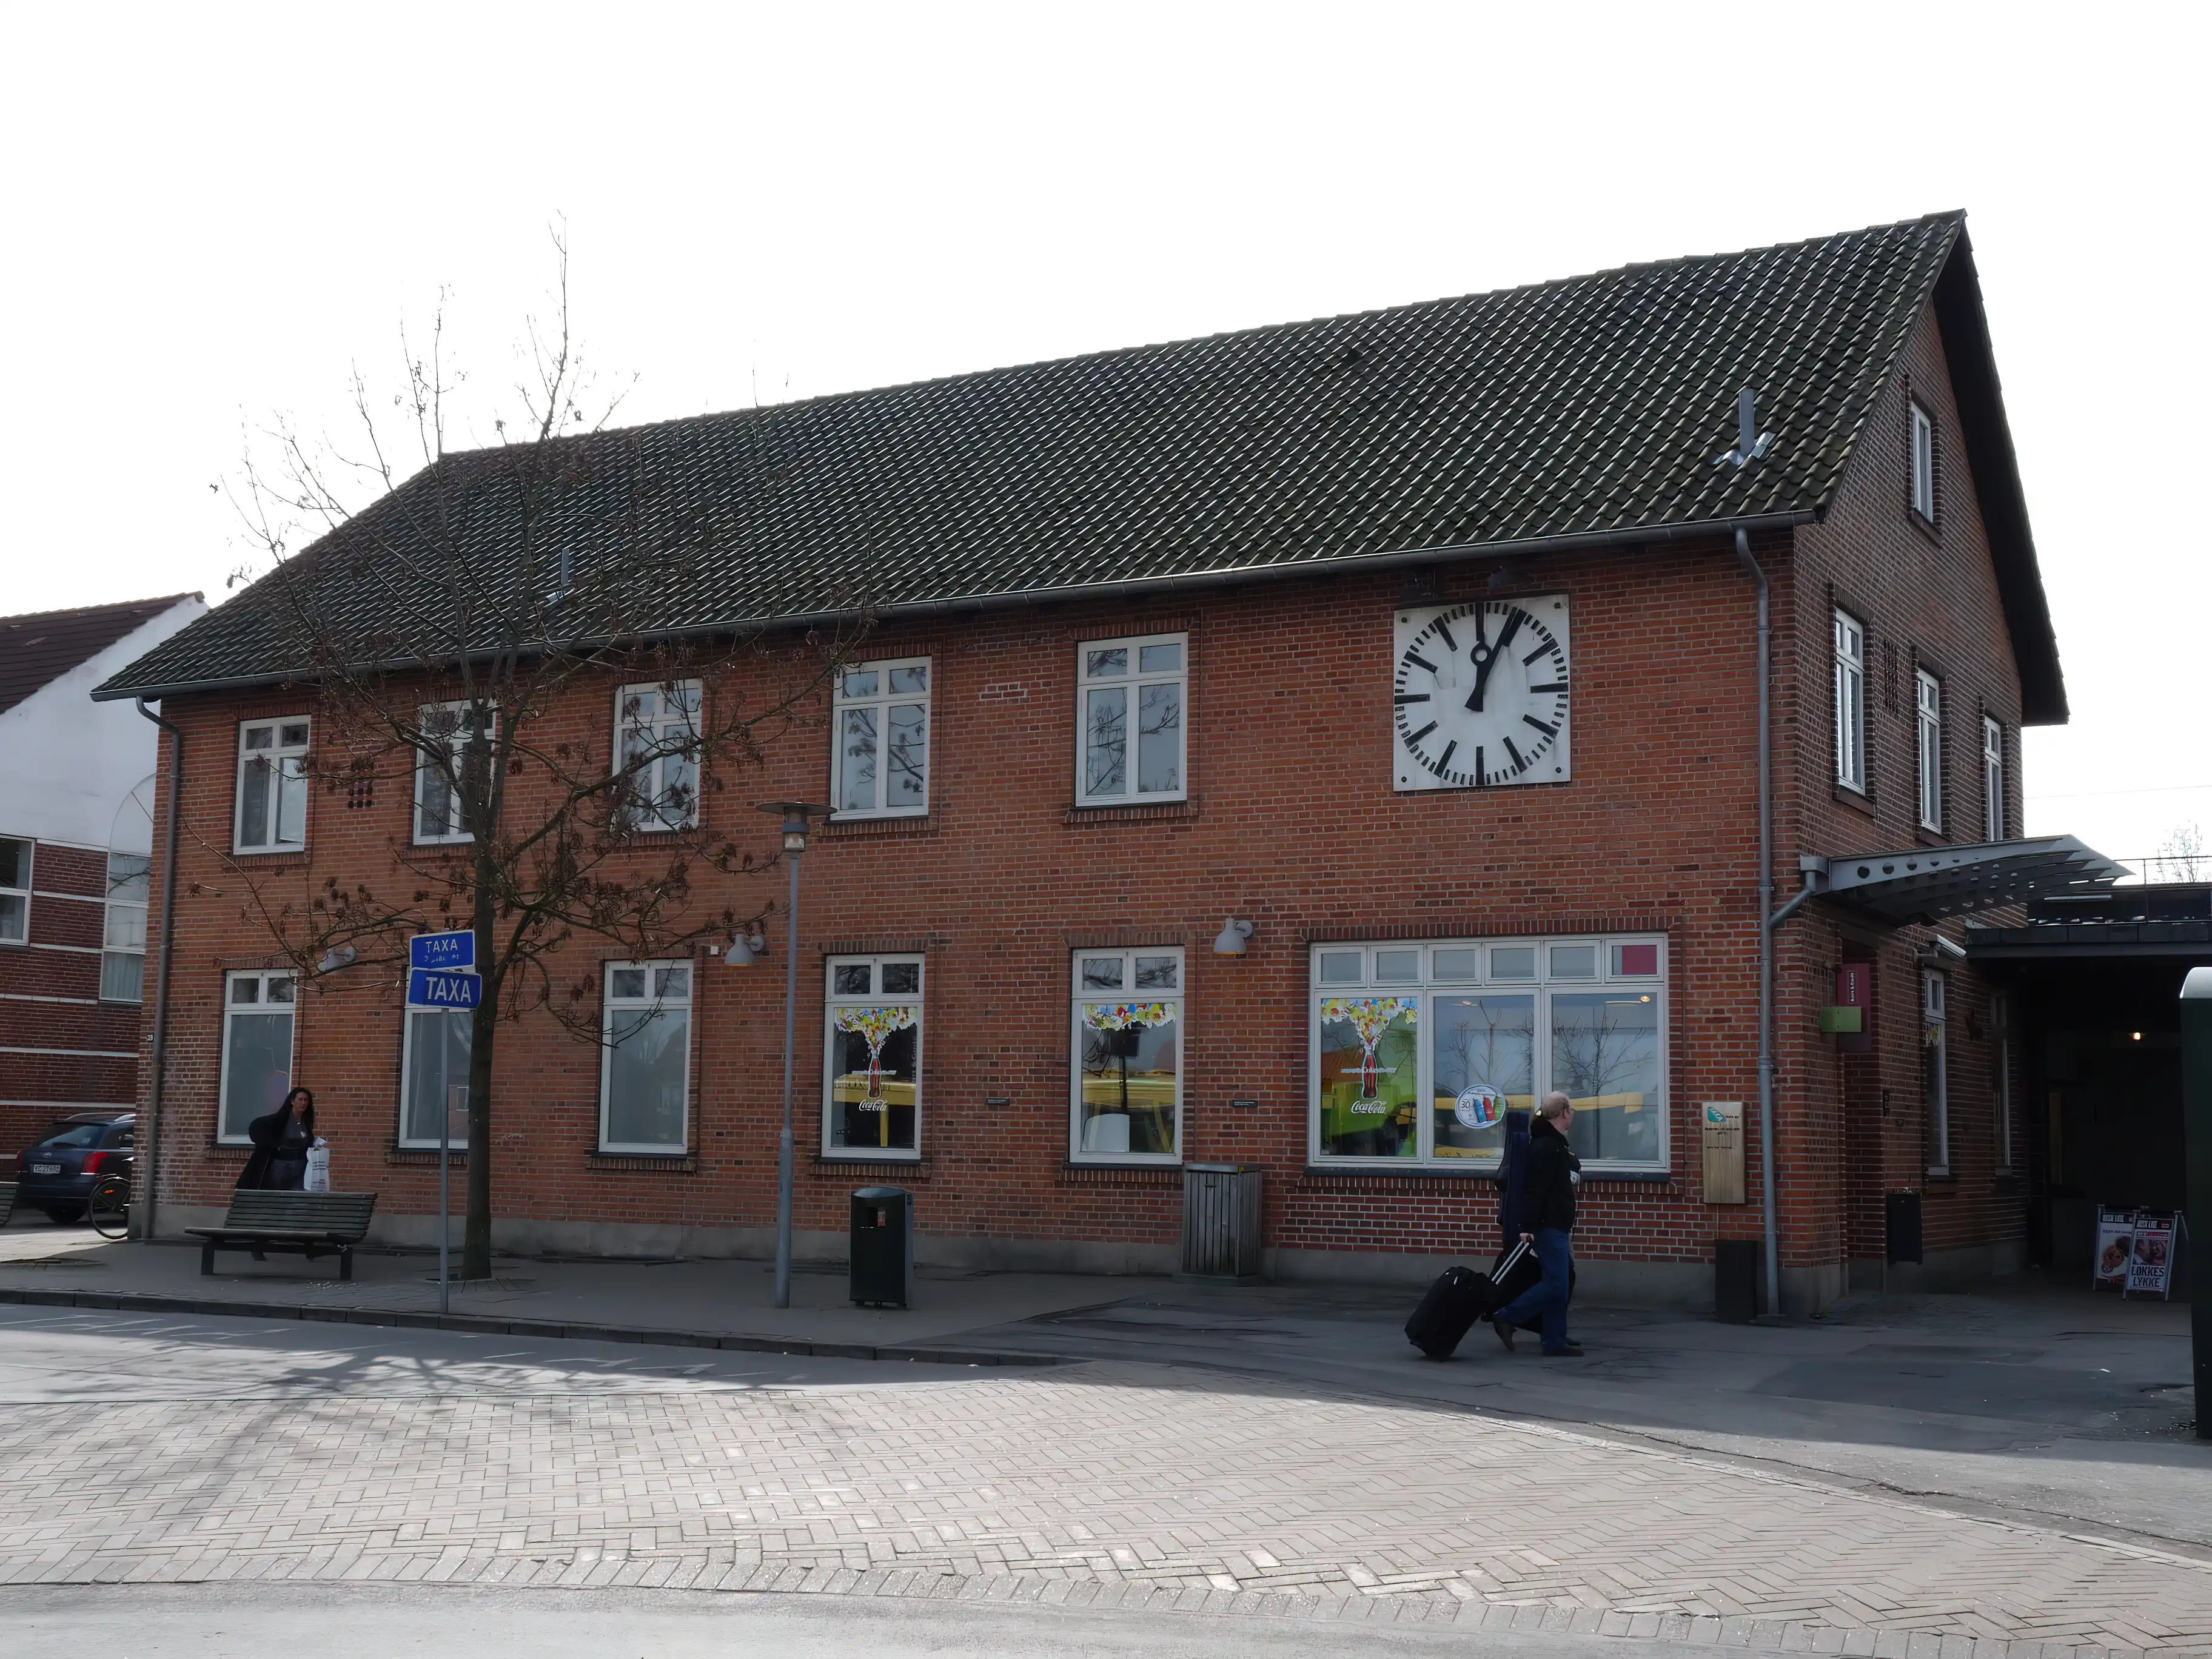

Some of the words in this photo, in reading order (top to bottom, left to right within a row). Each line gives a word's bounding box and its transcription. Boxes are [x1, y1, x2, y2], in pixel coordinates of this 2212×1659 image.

[425, 939, 458, 953] TAXA
[426, 977, 472, 1003] TAXA
[2133, 1276, 2162, 1287] LYKKE
